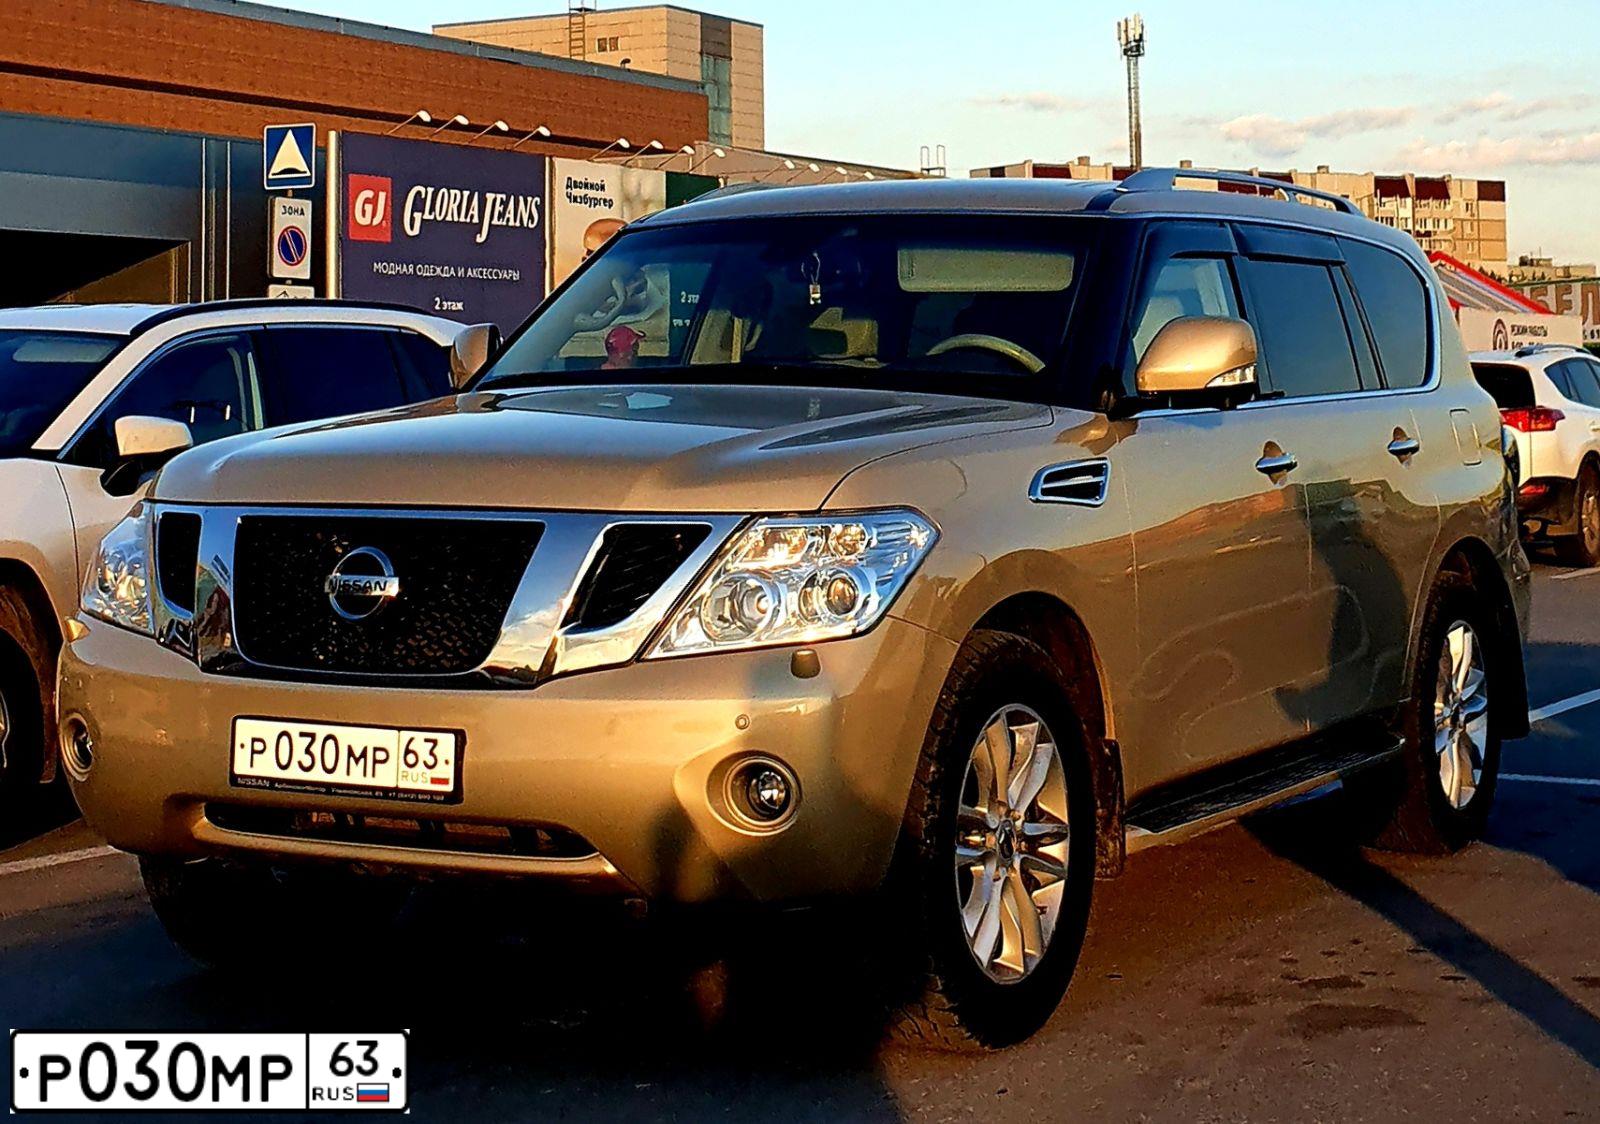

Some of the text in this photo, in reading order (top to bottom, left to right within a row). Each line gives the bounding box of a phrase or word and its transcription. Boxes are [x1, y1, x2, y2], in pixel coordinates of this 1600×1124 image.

[566, 176, 606, 193] Двойной
[354, 189, 387, 226] GJ
[566, 191, 614, 210] Чизбургер
[281, 205, 305, 217] ЗОНА
[403, 185, 540, 243] GLORIA JEANS
[373, 261, 520, 281] МОДНАЯ ОДЕЖДА И АКСЕССУАРЫ
[435, 297, 464, 312] 2 этаж
[329, 578, 388, 594] NISSAN
[401, 770, 428, 784] RUS
